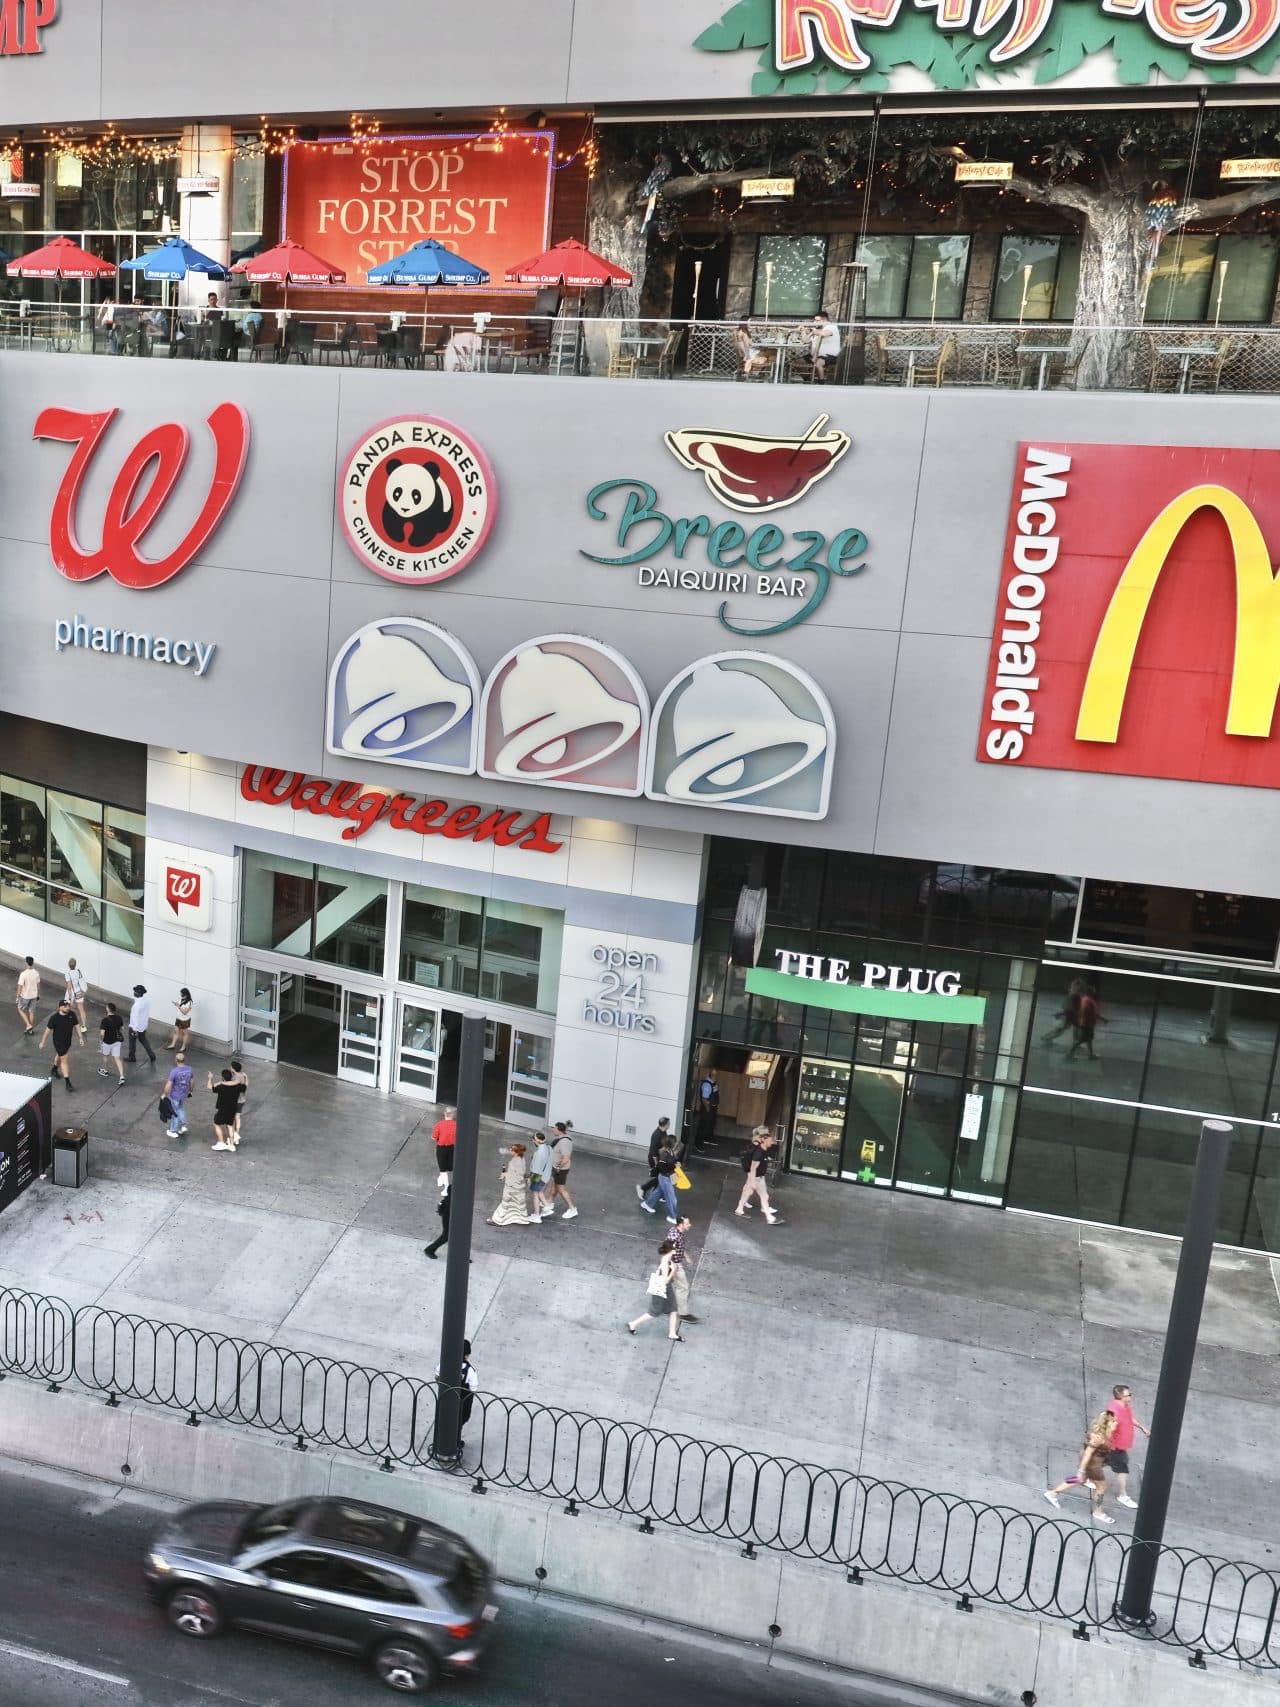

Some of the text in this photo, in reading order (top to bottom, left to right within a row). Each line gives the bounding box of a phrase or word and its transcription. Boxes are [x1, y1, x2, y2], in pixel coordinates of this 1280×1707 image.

[359, 153, 465, 194] STOP
[316, 196, 509, 236] FORREST
[357, 239, 460, 275] ST
[349, 427, 483, 498] PANDA EXPRESS
[353, 516, 475, 572] CHINESE KITCHEN
[578, 478, 869, 637] Breeze
[637, 566, 807, 598] DAIQUIRI BAR
[985, 446, 1072, 761] McDonald's
[55, 614, 218, 677] pharmacy
[240, 764, 565, 854] Walgreens
[591, 944, 658, 972] open
[774, 948, 963, 997] THE PLUG
[598, 969, 647, 1010] 24
[583, 999, 657, 1034] hours
